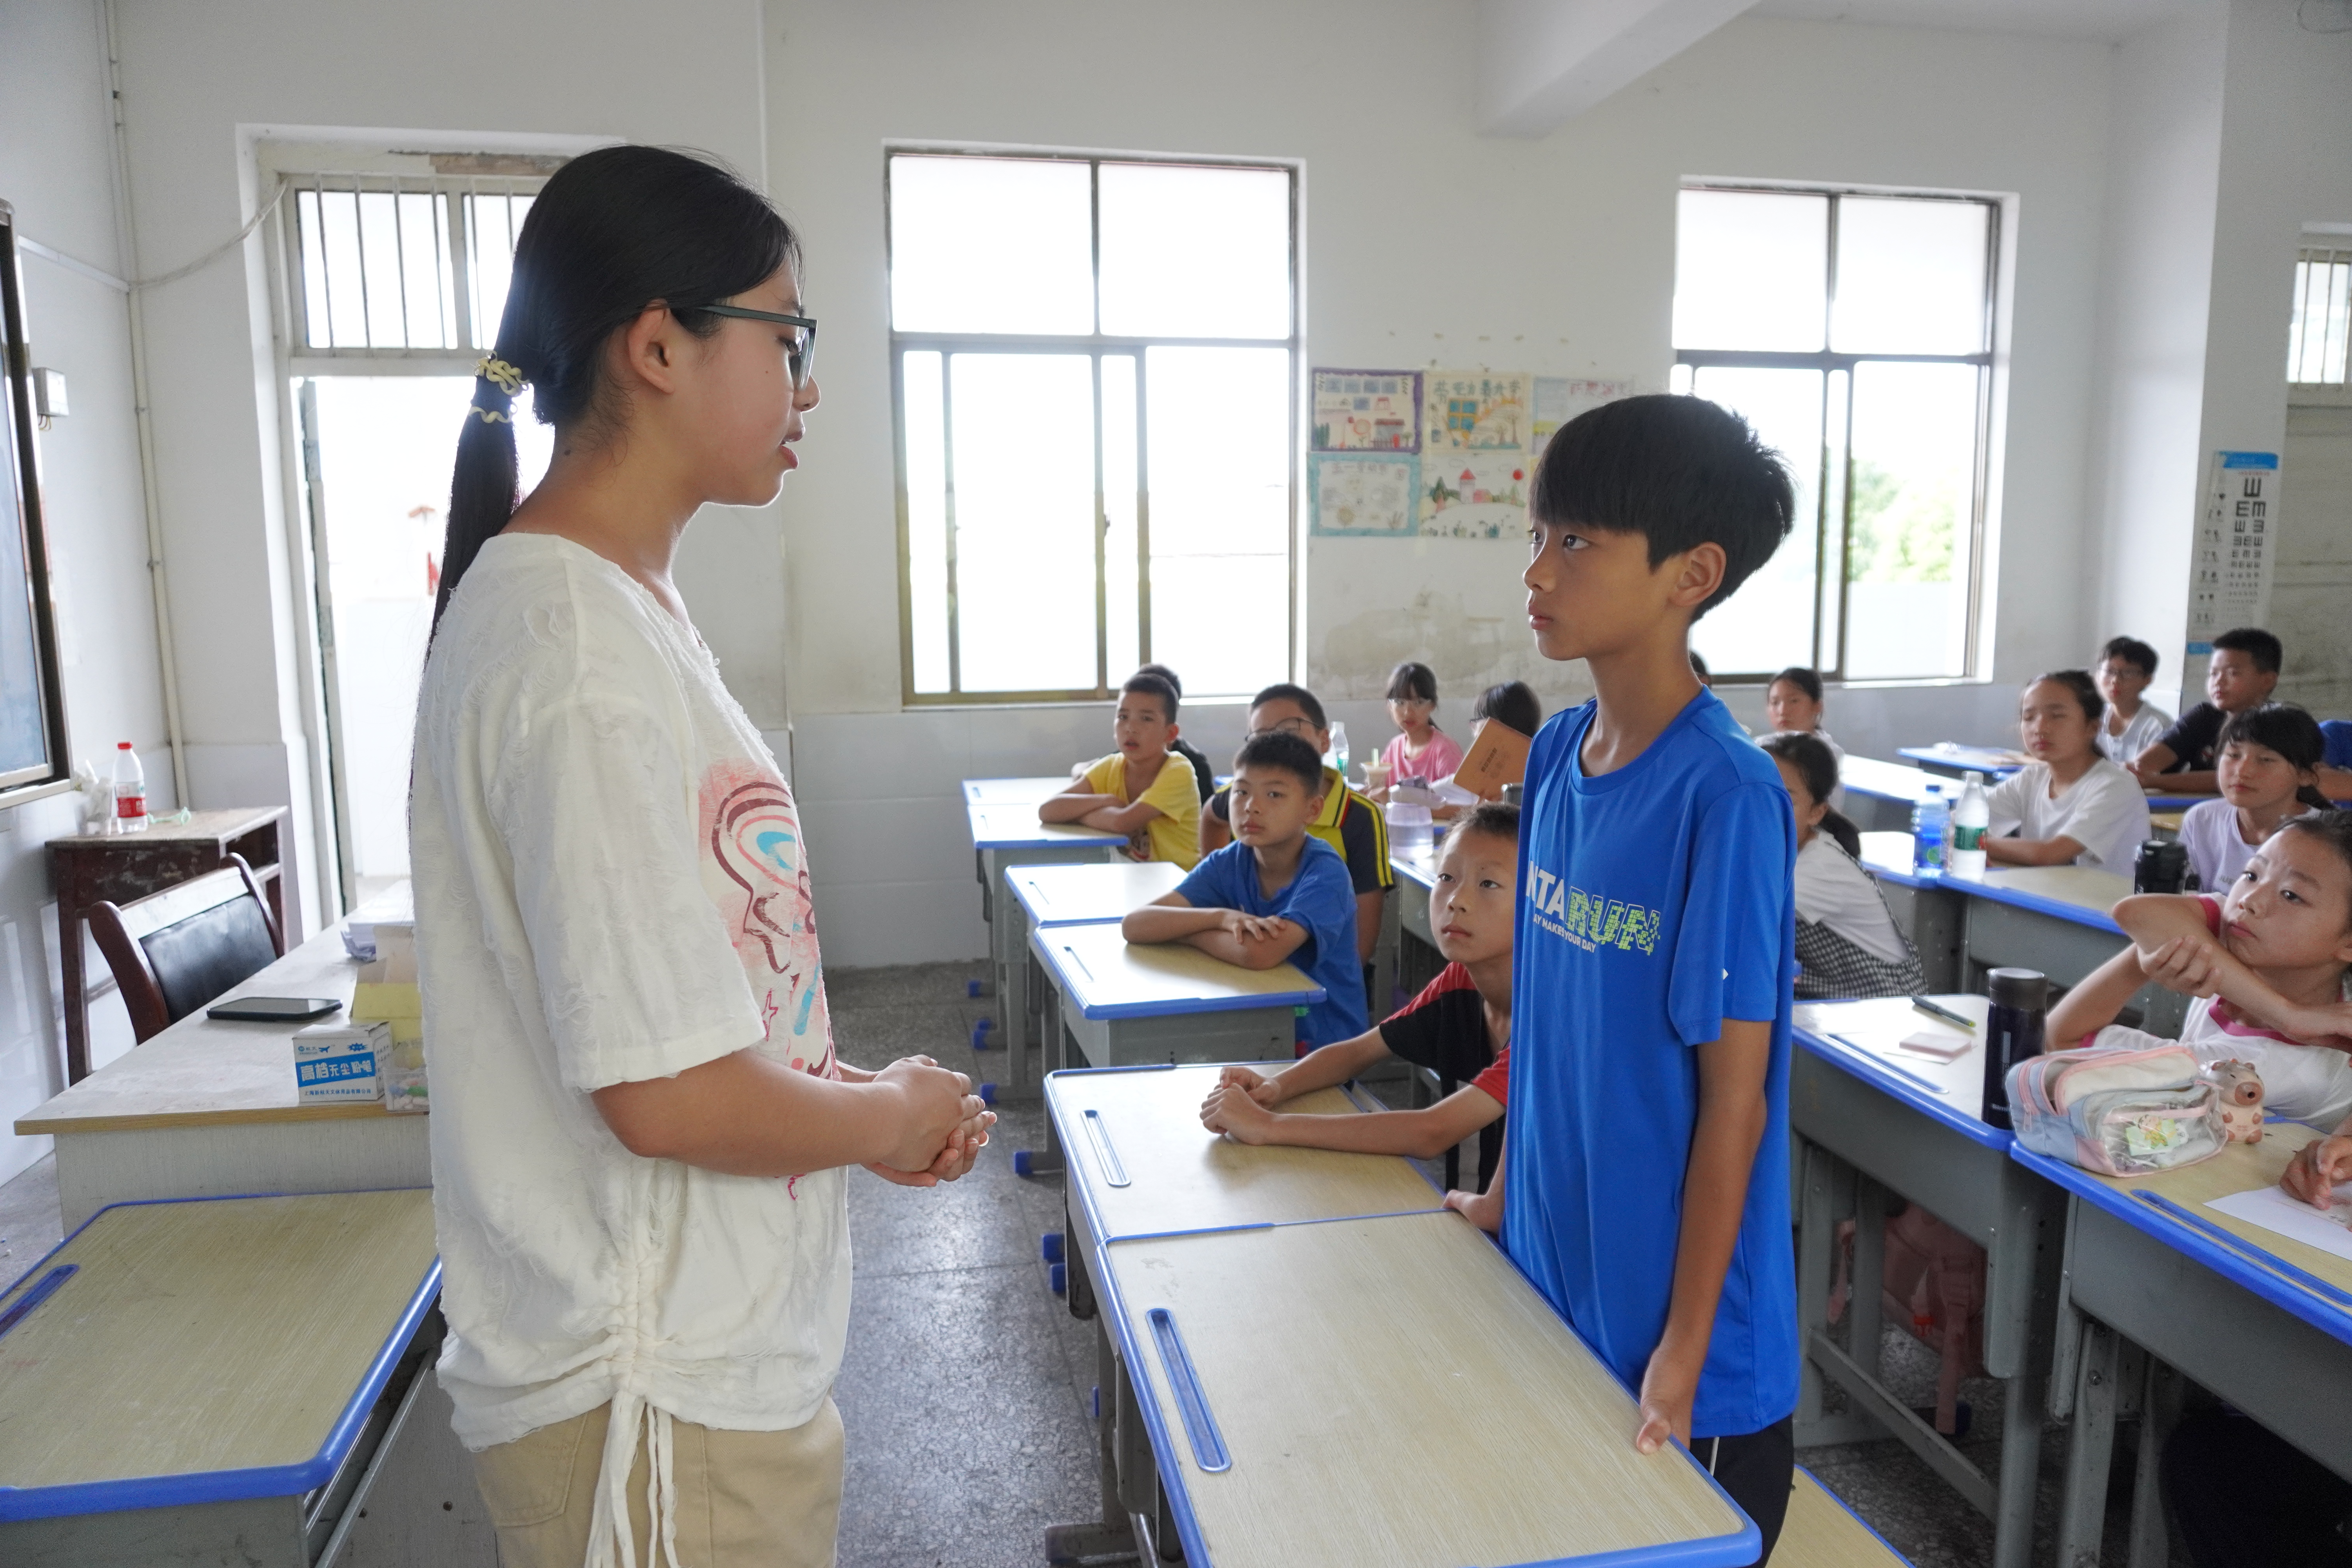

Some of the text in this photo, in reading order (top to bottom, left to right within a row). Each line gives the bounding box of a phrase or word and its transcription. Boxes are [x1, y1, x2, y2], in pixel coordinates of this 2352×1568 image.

[1564, 931, 1581, 947] YOUR
[1582, 939, 1596, 953] DAY
[300, 1060, 372, 1082] 高档无尘粉笔
